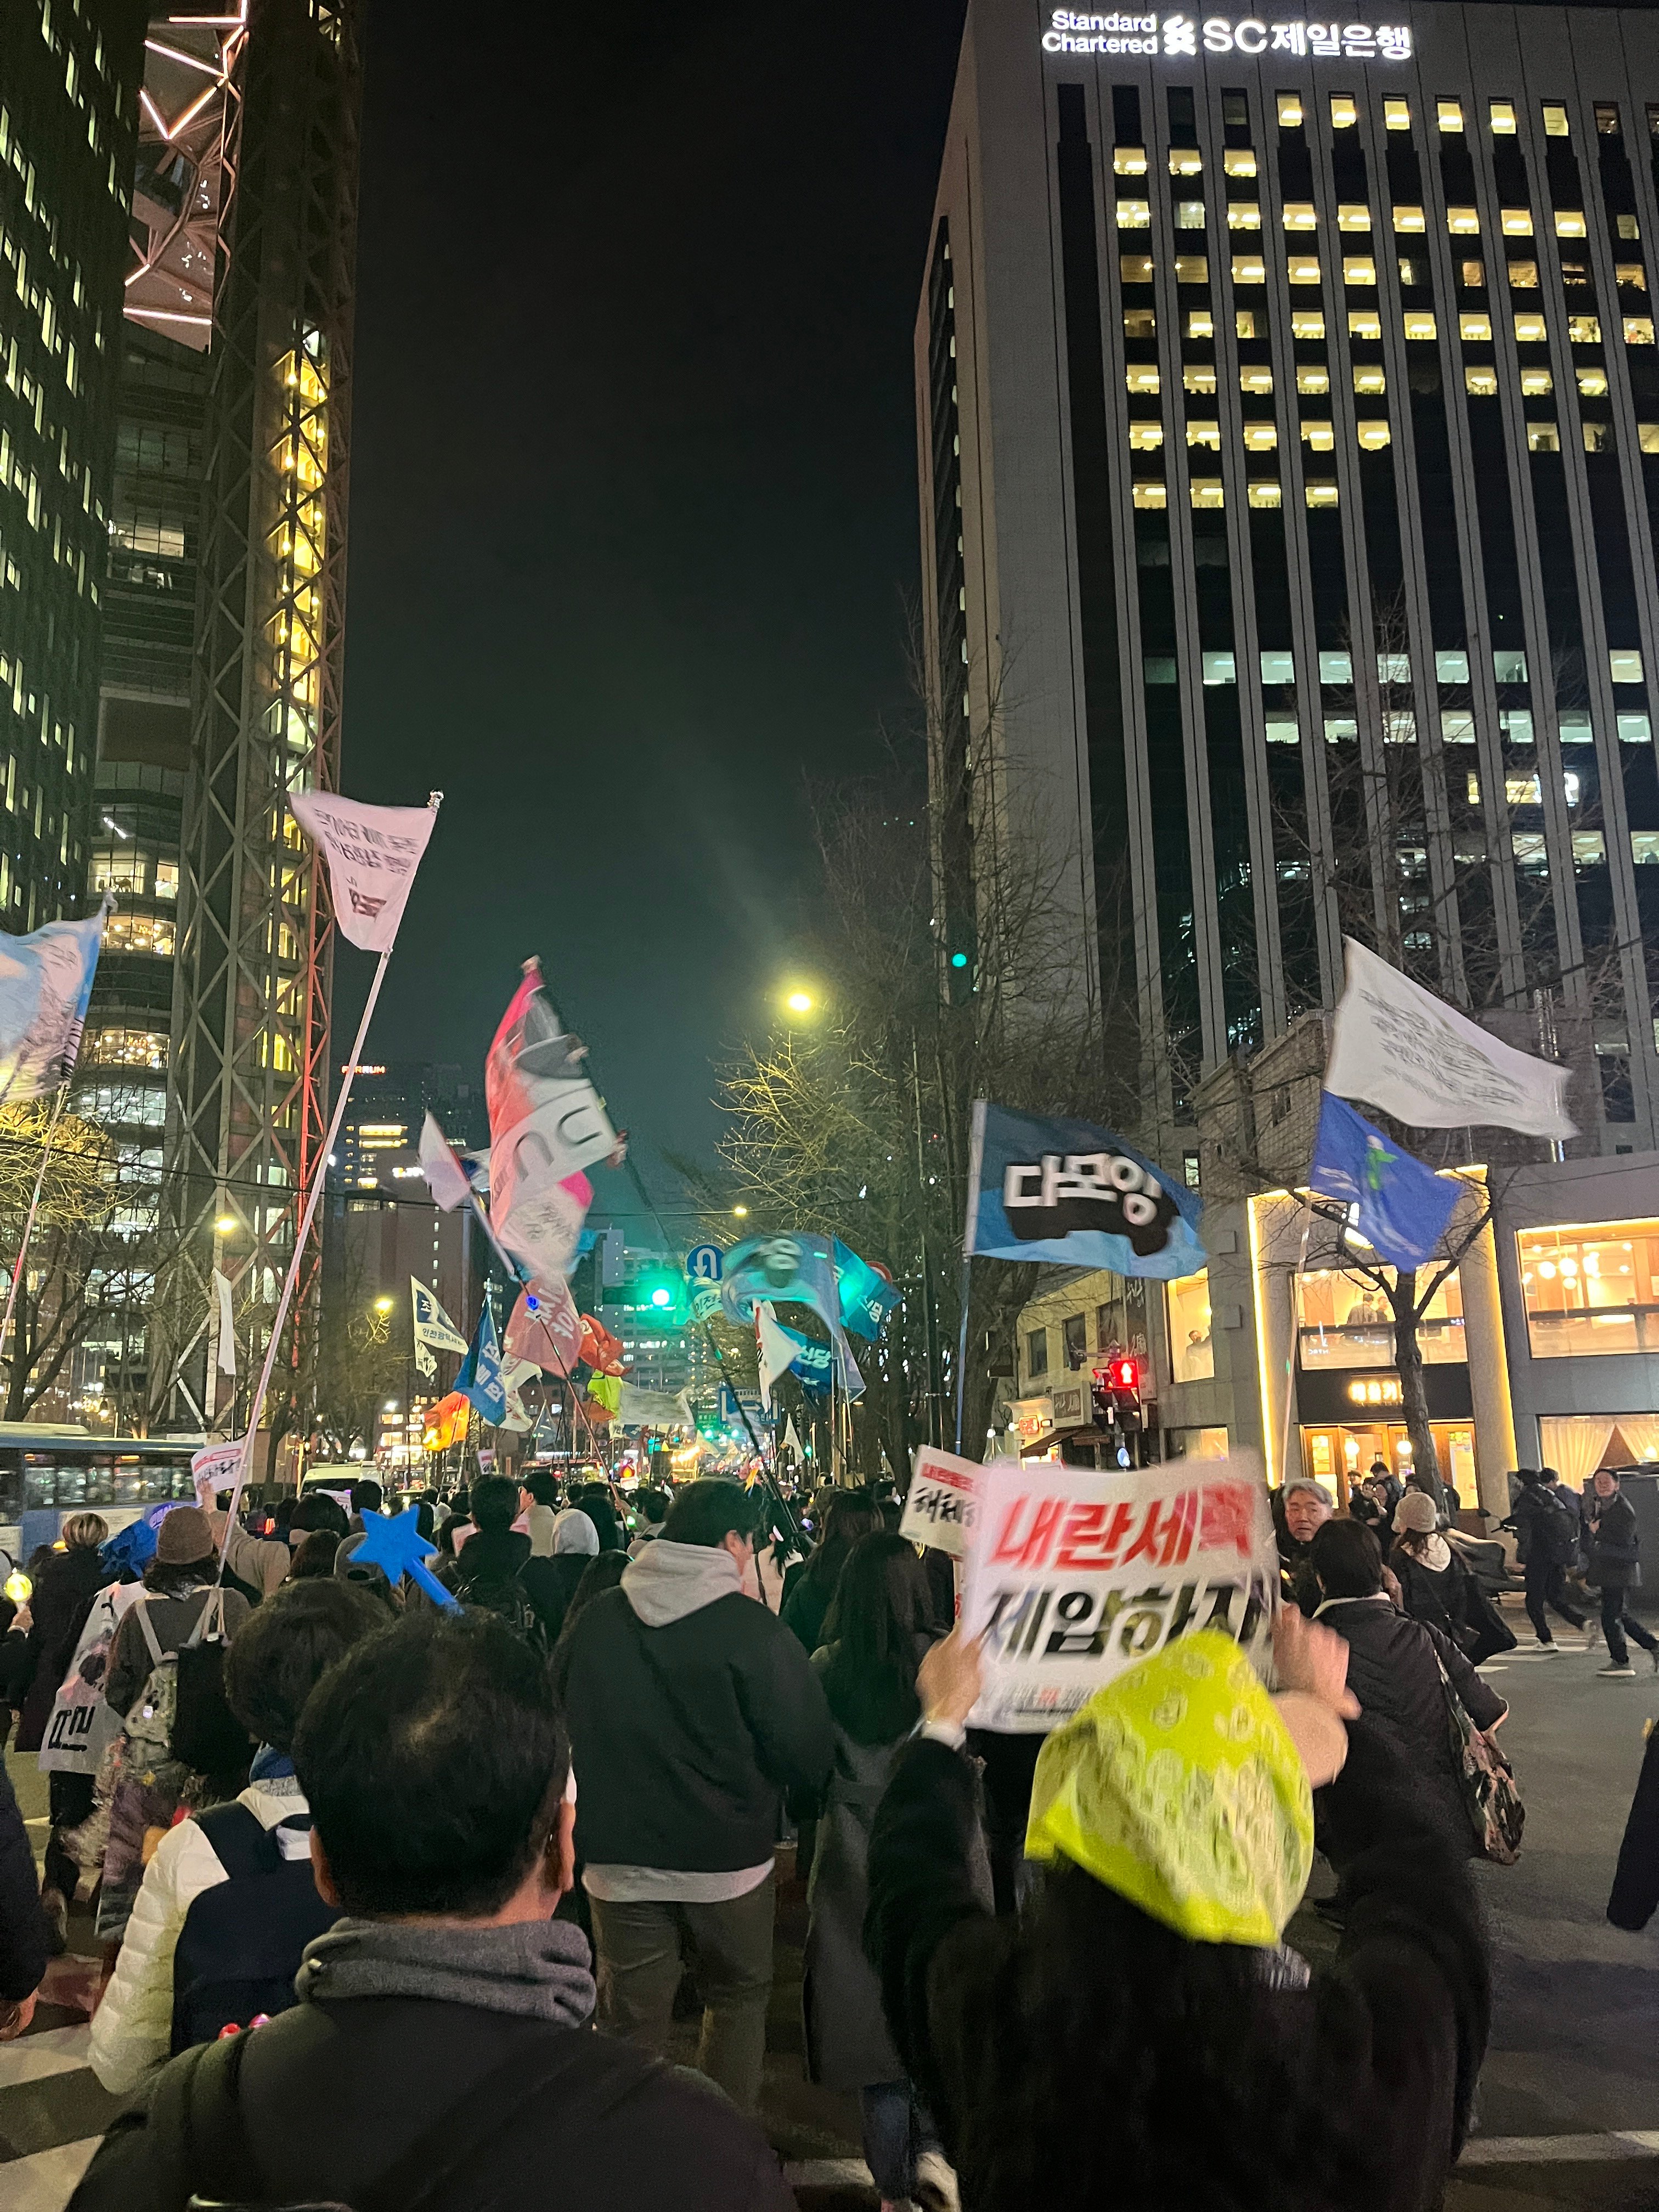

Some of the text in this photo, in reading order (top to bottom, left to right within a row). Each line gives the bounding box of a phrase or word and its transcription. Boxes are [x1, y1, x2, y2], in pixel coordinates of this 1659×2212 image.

[1051, 10, 1157, 33] Standard
[1042, 33, 1158, 55] Chartered
[341, 1065, 385, 1074] FRRUM
